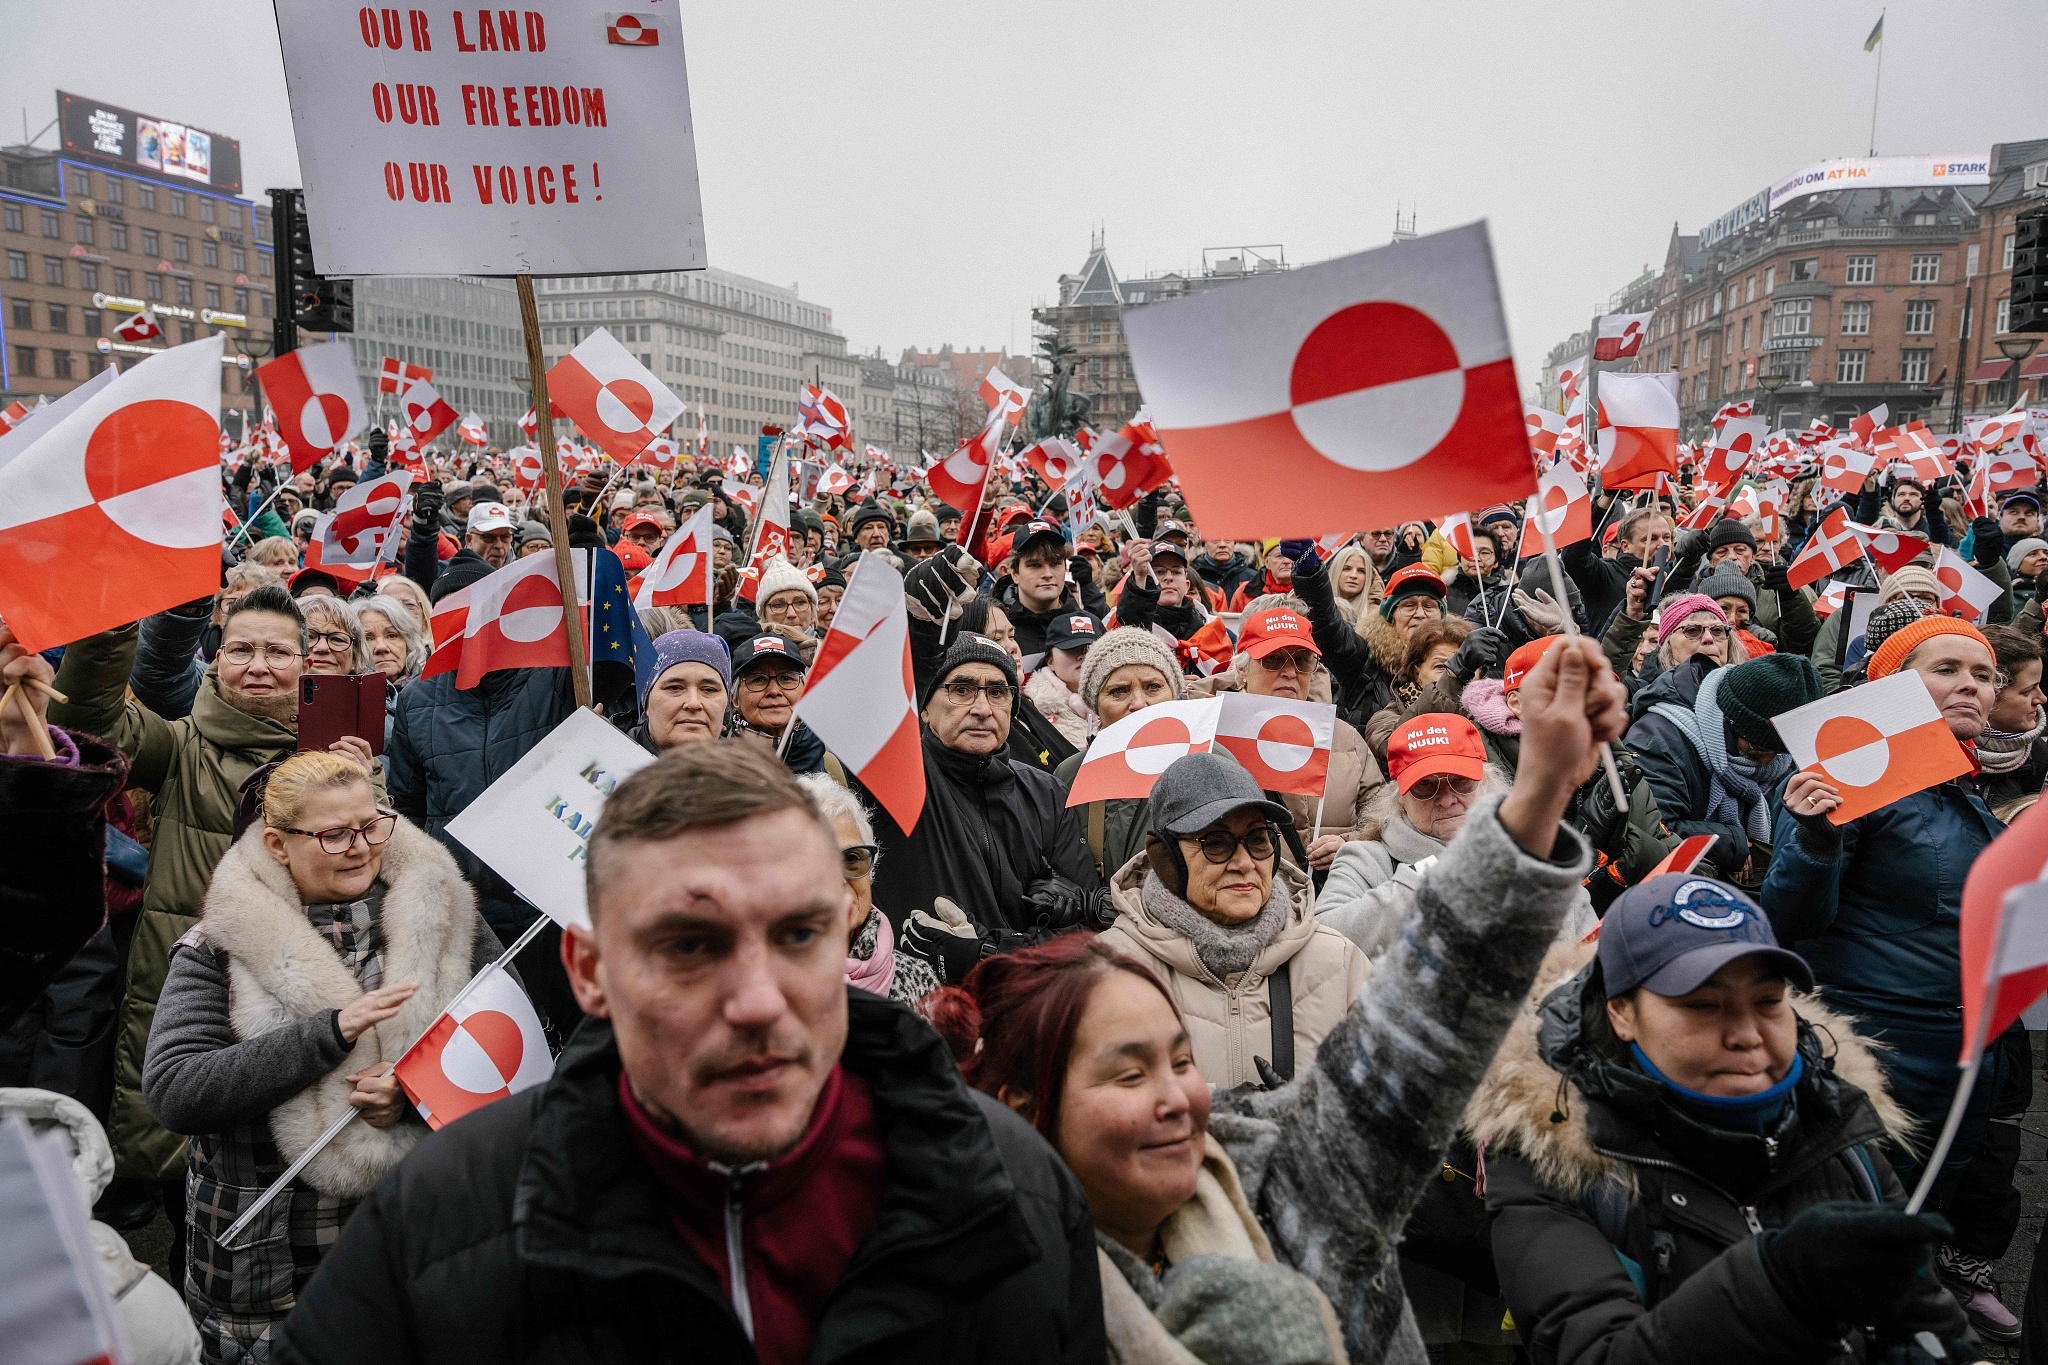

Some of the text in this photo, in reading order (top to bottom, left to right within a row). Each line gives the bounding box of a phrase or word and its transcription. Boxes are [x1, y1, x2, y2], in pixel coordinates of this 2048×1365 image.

[359, 7, 547, 52] OUR LAND
[372, 82, 608, 128] OUR FREEDOM
[1948, 163, 1986, 173] STARK
[384, 161, 451, 203] OUR
[1805, 171, 1824, 184] OM
[1827, 169, 1844, 180] AT
[1698, 187, 1771, 252] POLITIKEN
[1265, 614, 1297, 624] Nu det
[1266, 623, 1299, 632] NUUK!
[1407, 726, 1448, 740] Nu det
[1407, 736, 1450, 751] NUUK!
